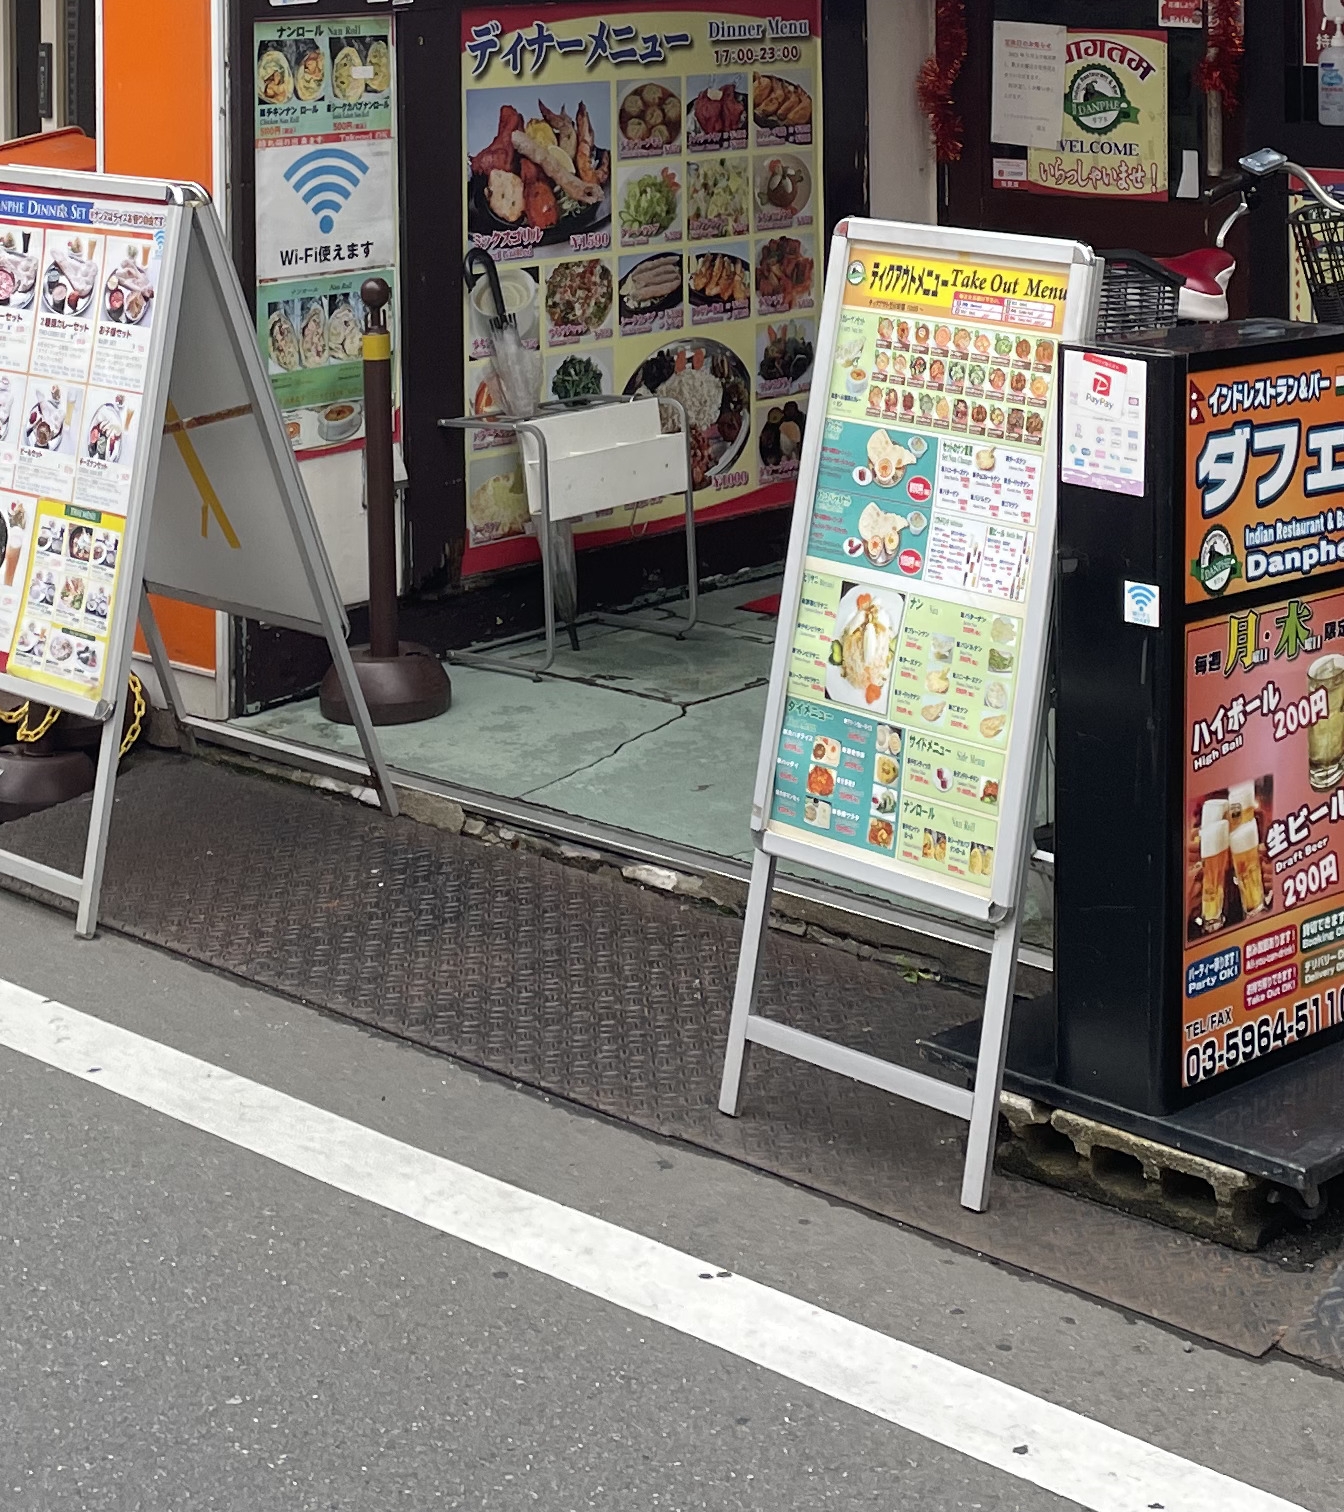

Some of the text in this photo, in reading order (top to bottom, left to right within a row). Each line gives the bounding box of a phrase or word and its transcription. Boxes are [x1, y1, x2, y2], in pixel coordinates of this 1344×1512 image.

[276, 25, 324, 39] ナンロール
[708, 17, 810, 43] Dinner Menu
[467, 20, 691, 76] ディナーメニュー
[713, 45, 801, 65] 17:00-23:00
[70, 204, 87, 220] SET
[280, 241, 374, 266] Wi-Fi使えます
[950, 268, 1067, 302] Take Out Menu
[1085, 393, 1114, 410] PayPay
[1208, 369, 1331, 417] インドレストラン&バー
[1245, 523, 1274, 549] Indian
[1275, 514, 1325, 541] Restaurant
[1326, 509, 1334, 529] &
[1195, 651, 1221, 674] 毎週
[787, 700, 834, 722] タイメニュー
[1192, 681, 1281, 753] ハイボール
[1273, 685, 1329, 741] 200円
[909, 734, 951, 756] サイドメニュー
[1193, 735, 1243, 771] High Ball
[956, 749, 986, 767] Side Menu
[903, 799, 936, 820] ナンロール
[1275, 836, 1329, 874] Draft Beer
[1282, 850, 1339, 910] 290円
[1303, 930, 1334, 948] Booking
[1188, 974, 1216, 995] Party
[1304, 967, 1334, 984] Delivery
[1246, 992, 1265, 1008] Take
[1186, 1008, 1233, 1039] TEL/FAX
